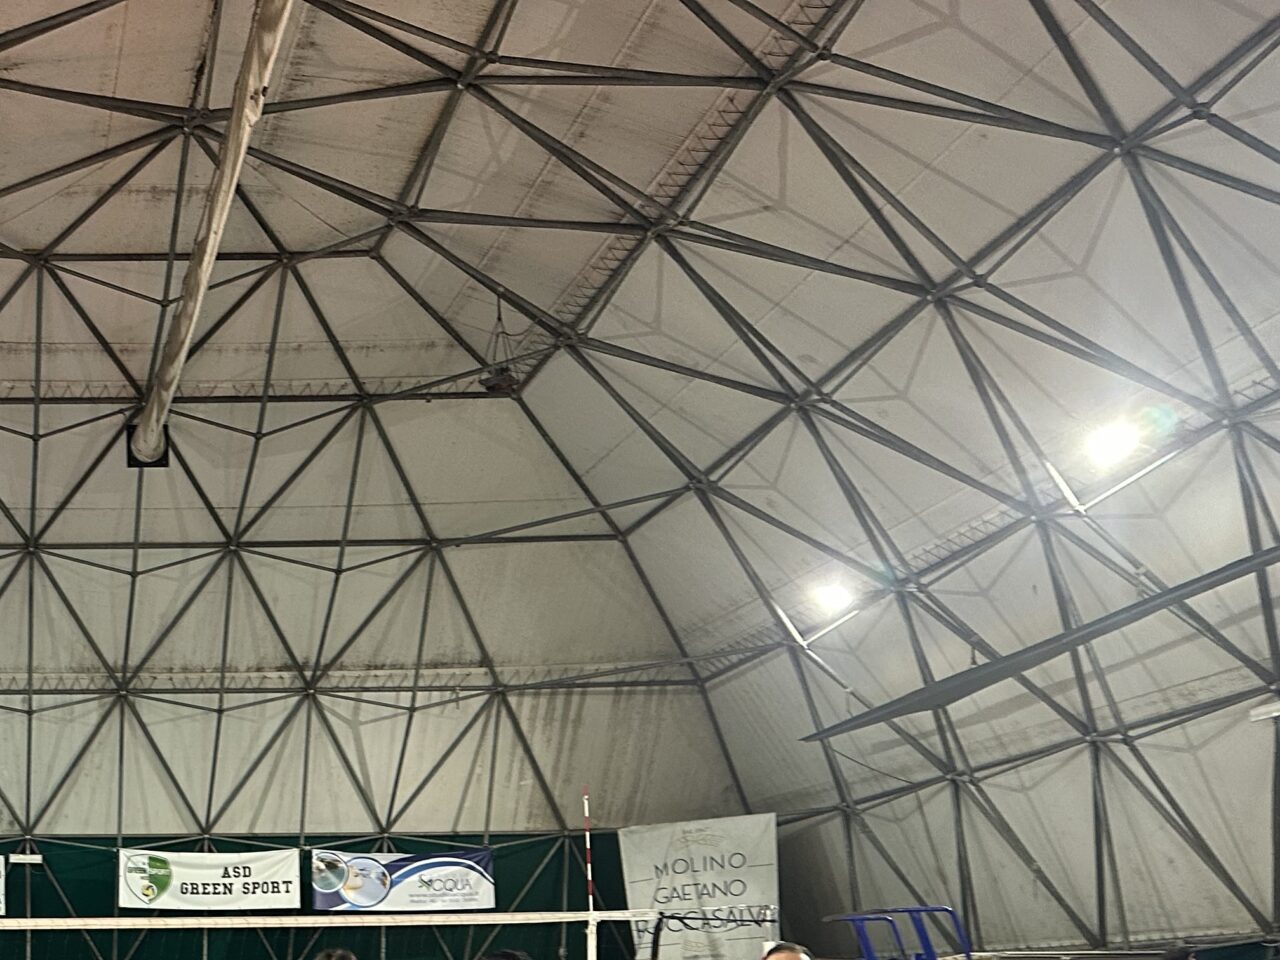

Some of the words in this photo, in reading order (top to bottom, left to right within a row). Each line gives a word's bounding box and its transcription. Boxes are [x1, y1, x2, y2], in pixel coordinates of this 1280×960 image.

[221, 866, 252, 878] ASD
[653, 852, 747, 879] MOLINO
[180, 882, 235, 895] GREEN
[242, 880, 293, 895] SPORT
[654, 879, 747, 904] GAETANO
